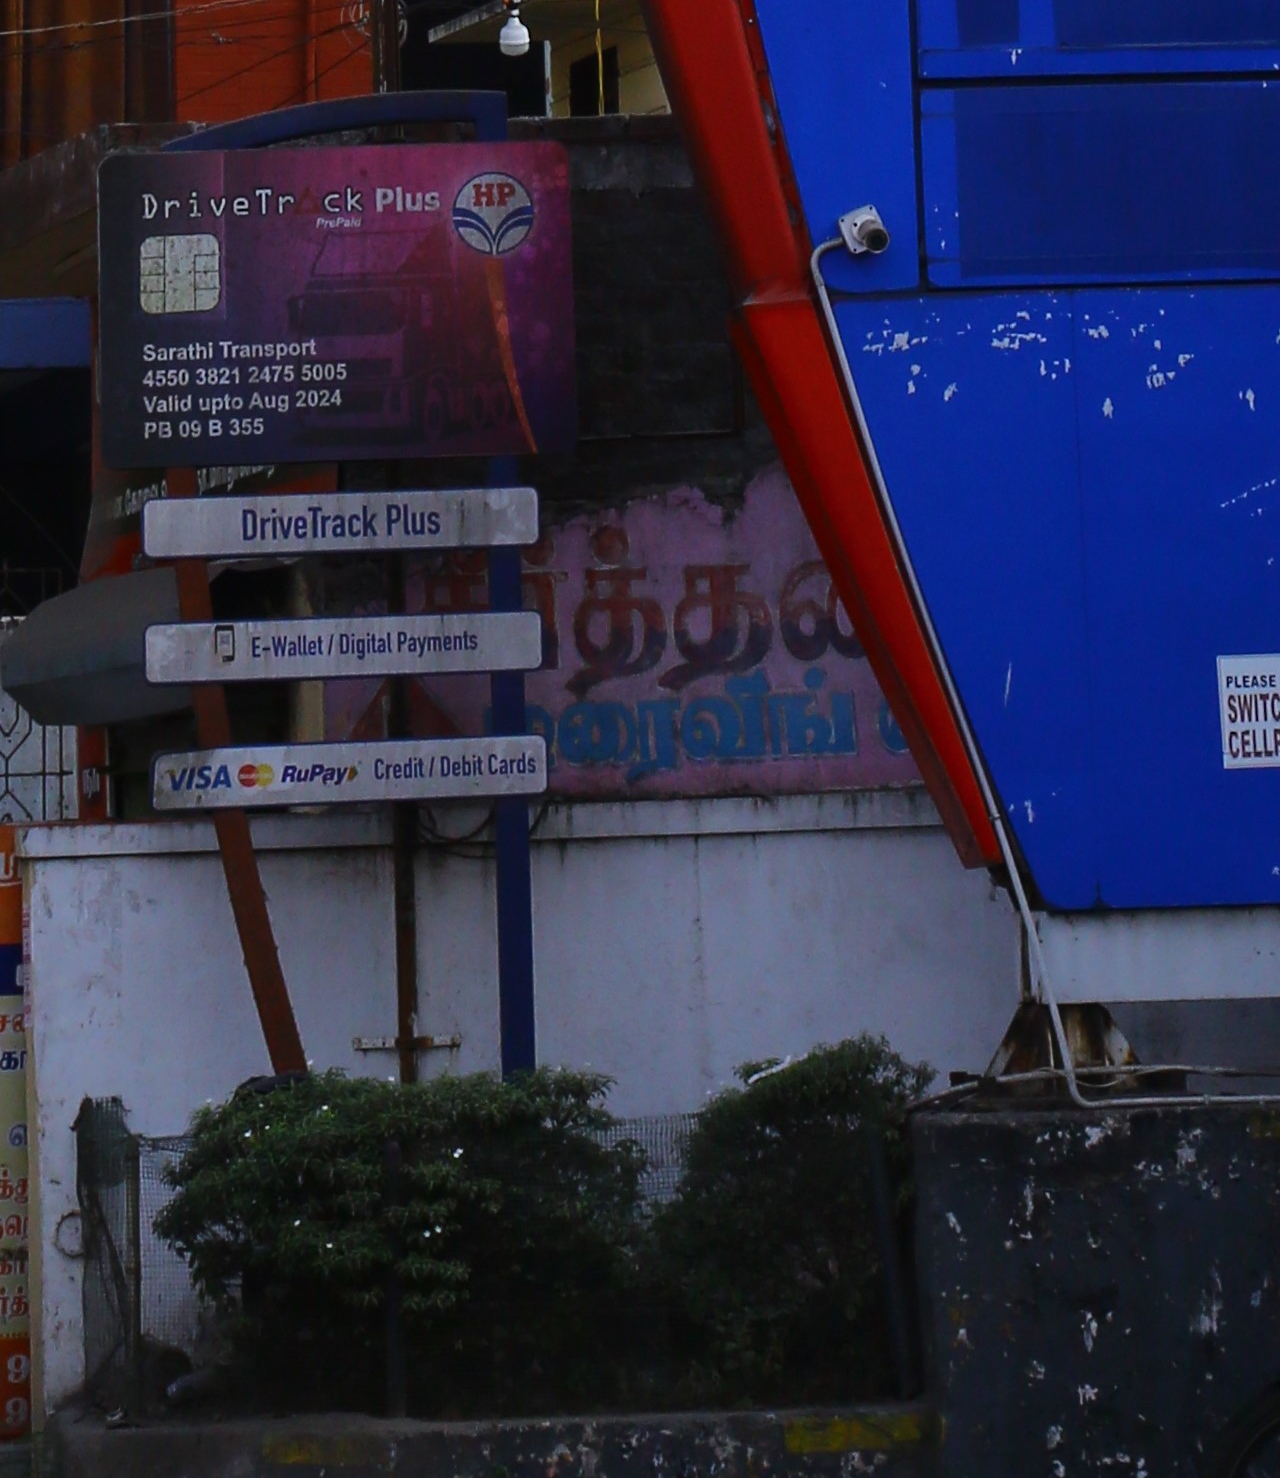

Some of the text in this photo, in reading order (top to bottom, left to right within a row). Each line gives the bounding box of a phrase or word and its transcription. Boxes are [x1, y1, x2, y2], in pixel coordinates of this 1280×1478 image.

[375, 186, 441, 212] Plus
[473, 183, 517, 207] HP
[142, 339, 317, 362] Sarathi Transport
[142, 363, 347, 387] 4550 3821 2475 5005
[143, 389, 343, 415] Valid upto Aug 2024
[144, 418, 265, 439] PB 09 B 355
[242, 504, 441, 541] DriveTrack Plus
[251, 634, 324, 658] E-Wallet
[340, 633, 392, 660] Digital
[397, 630, 478, 657] Payments
[1226, 675, 1276, 689] PLEASE
[169, 764, 231, 791] VISA
[281, 765, 348, 785] RuPay
[374, 756, 425, 780] Credit
[440, 754, 484, 778] Debit
[488, 753, 536, 776] Cards
